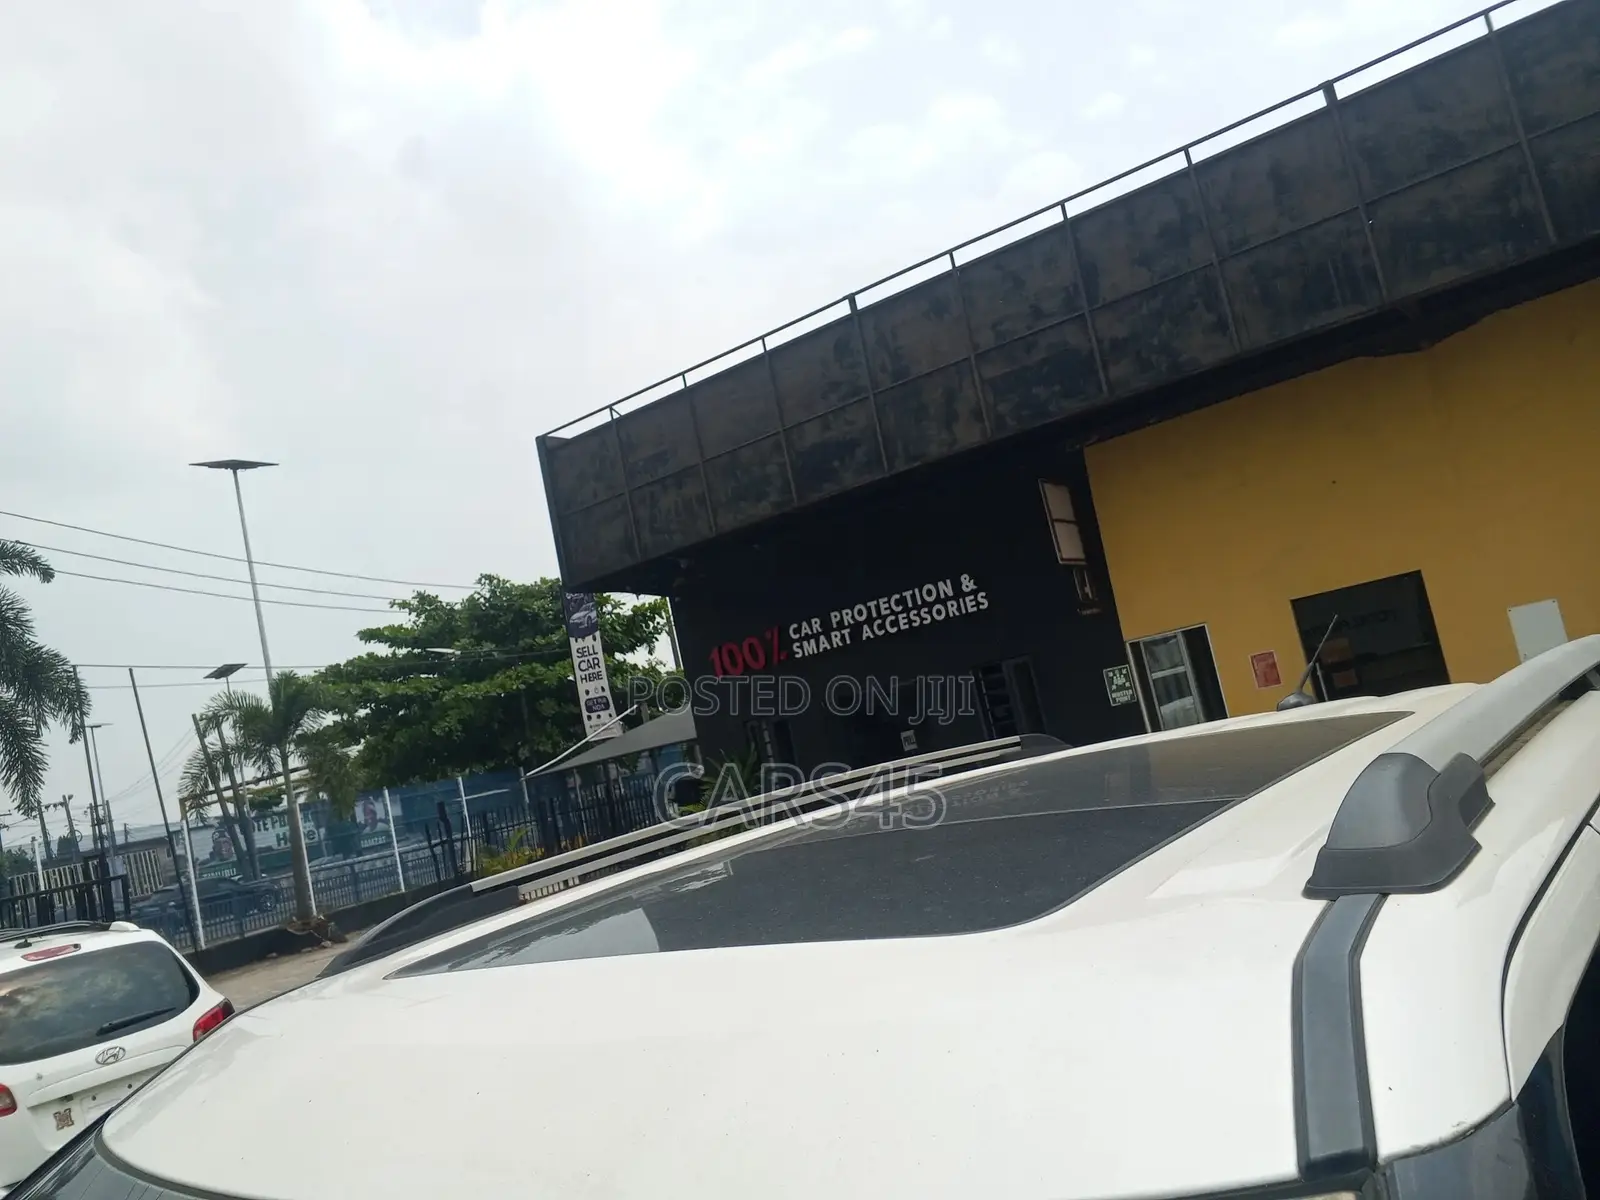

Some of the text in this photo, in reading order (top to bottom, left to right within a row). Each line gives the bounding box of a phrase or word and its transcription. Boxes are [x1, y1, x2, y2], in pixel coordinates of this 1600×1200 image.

[789, 573, 978, 640] CAR PROTECTION &
[792, 591, 989, 659] SMART ACCESSORIES
[576, 644, 598, 659] SELL
[578, 657, 601, 672] CAR
[708, 626, 788, 679] 100%
[580, 671, 603, 684] HERE
